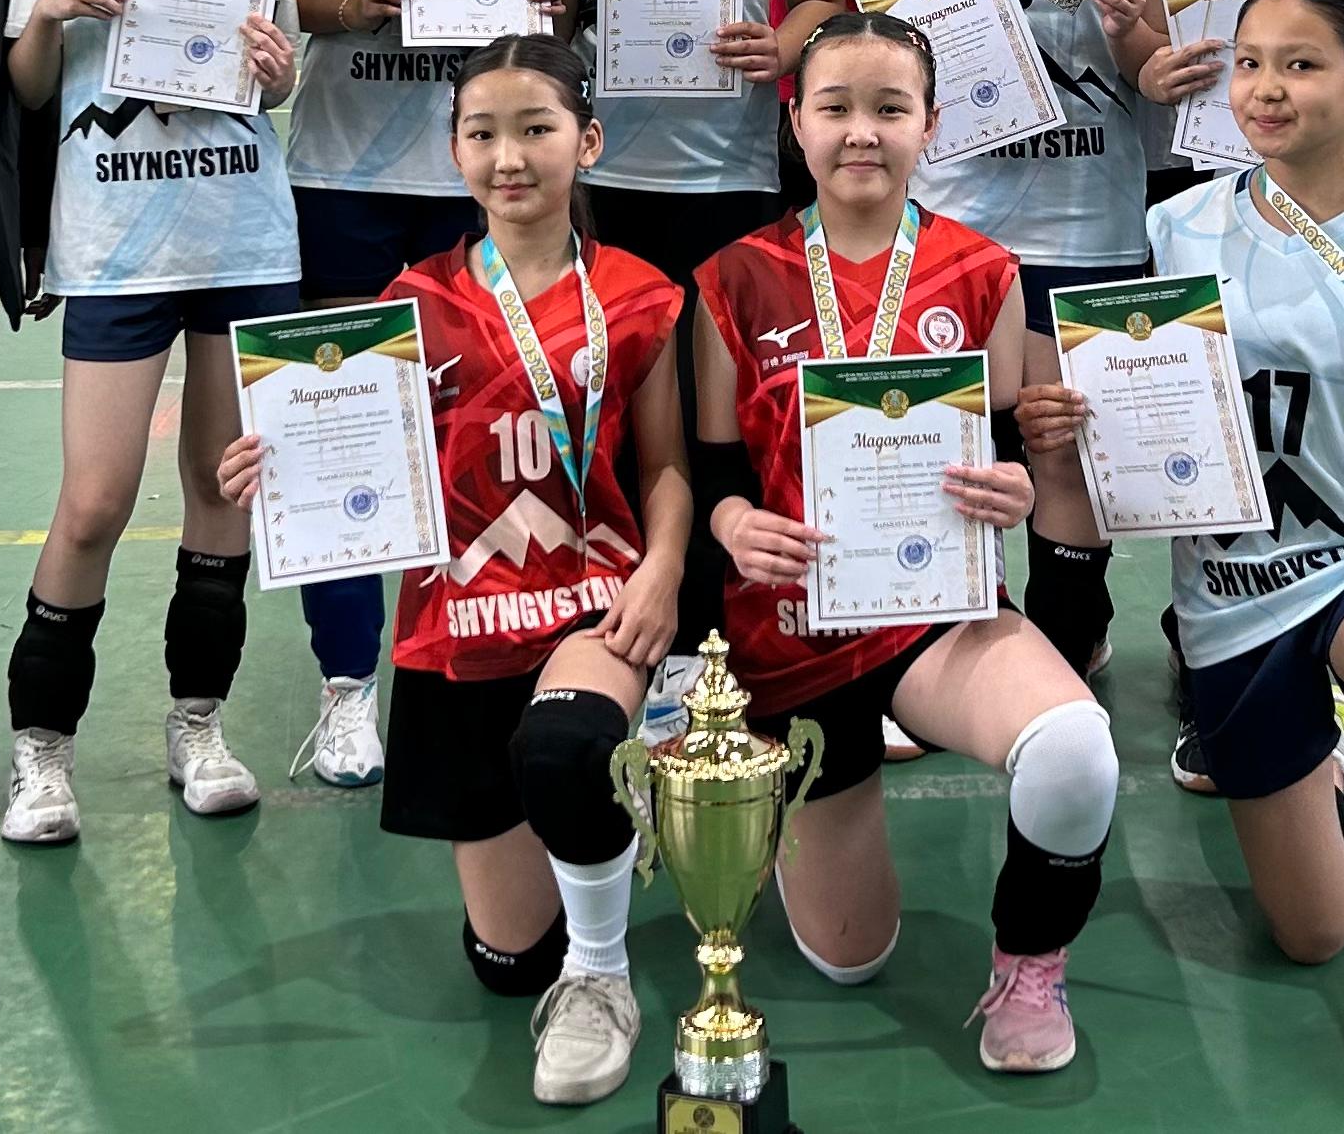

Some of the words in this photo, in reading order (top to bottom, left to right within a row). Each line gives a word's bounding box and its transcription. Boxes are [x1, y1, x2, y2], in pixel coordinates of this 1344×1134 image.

[95, 143, 260, 183] SHYNGYSTAU
[808, 244, 844, 359] QAZAQSTAN
[500, 289, 557, 401] QAZAQSTAN
[1104, 351, 1189, 377] Мадақтама
[288, 381, 379, 408] Мадақтама
[1242, 368, 1311, 457] 17
[489, 409, 552, 483] 10
[851, 430, 943, 455] Мадақтама
